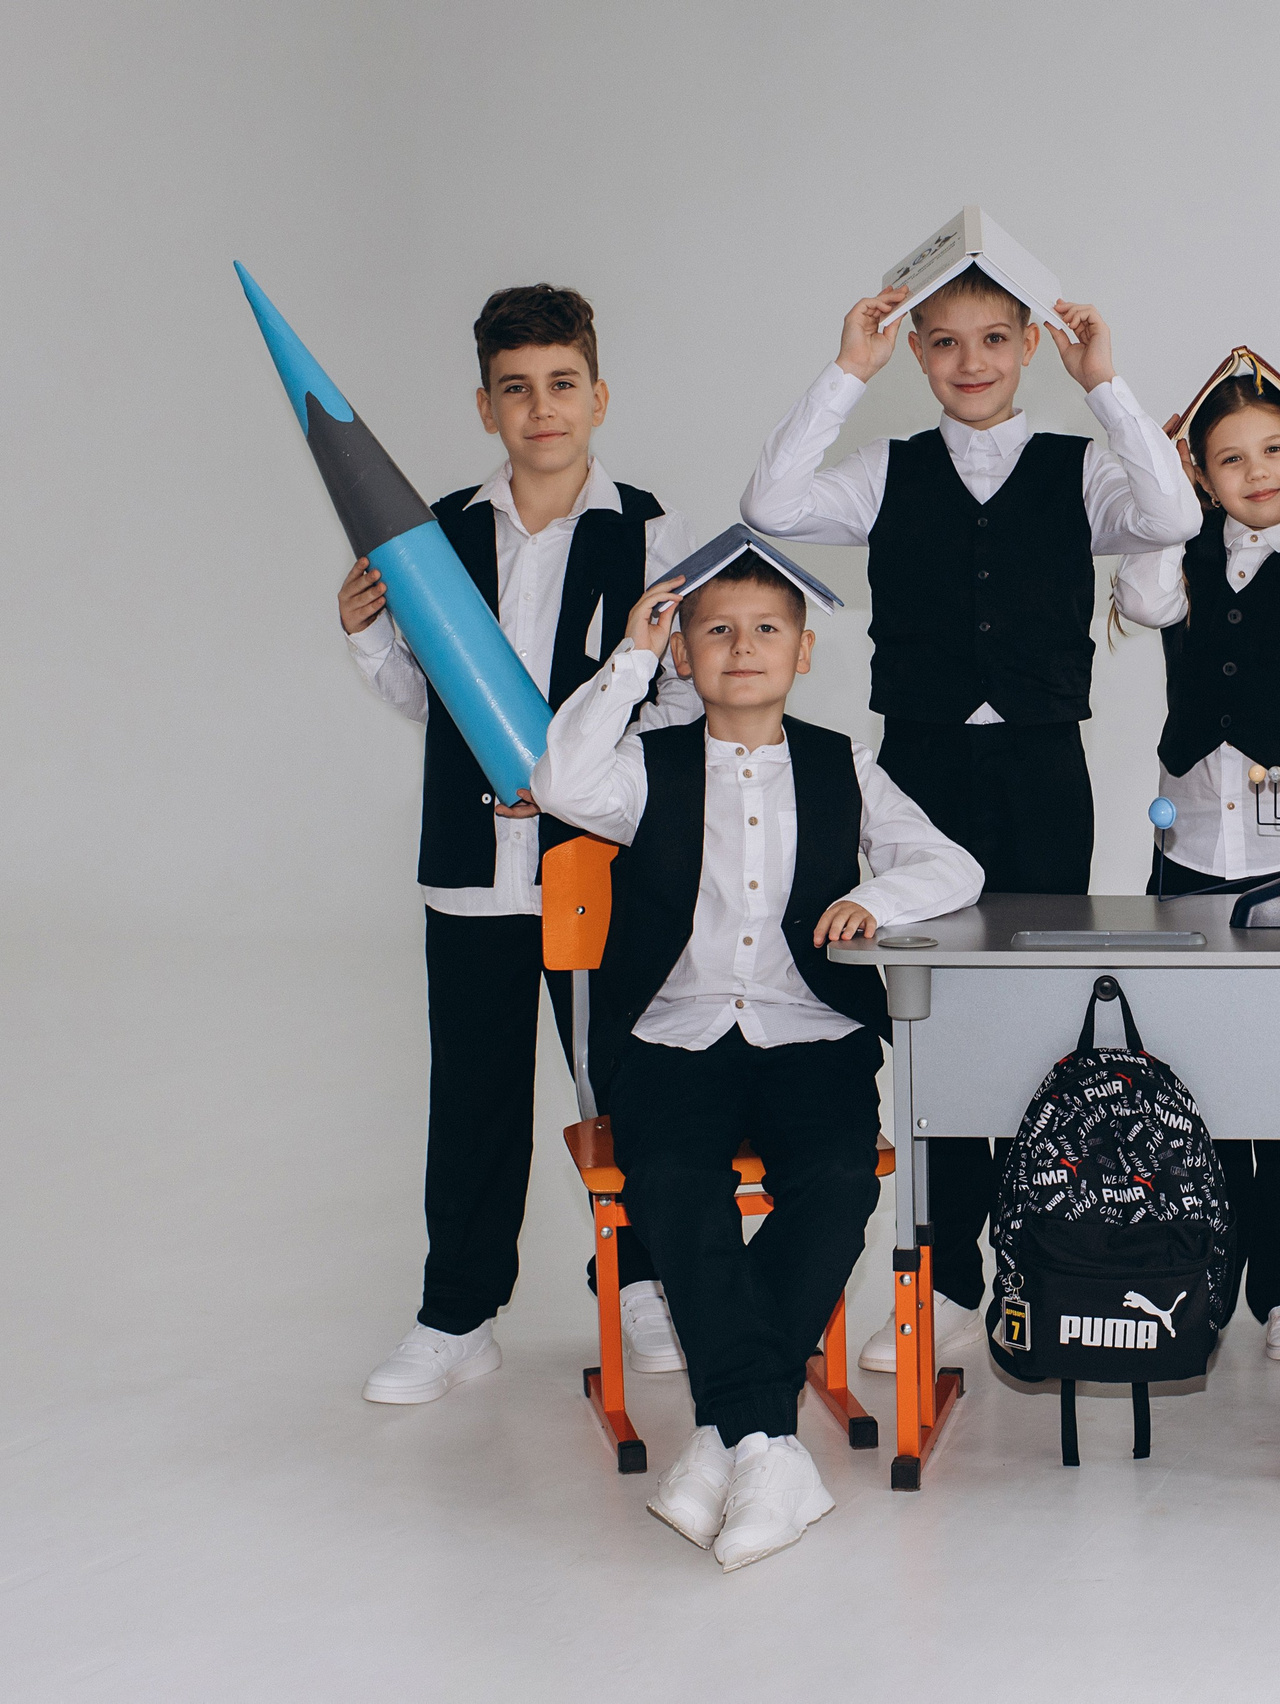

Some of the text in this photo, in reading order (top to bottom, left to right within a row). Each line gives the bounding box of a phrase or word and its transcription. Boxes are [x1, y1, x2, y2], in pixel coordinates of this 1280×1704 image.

[1099, 1054, 1148, 1066] PUMA
[1156, 1090, 1170, 1104] WE
[1154, 1102, 1192, 1134] PUMA
[1032, 1170, 1068, 1186] UMA
[1102, 1174, 1117, 1184] WE
[1102, 1186, 1145, 1203] PUMA
[1180, 1182, 1194, 1194] WE
[1100, 1206, 1122, 1218] COOL
[1012, 1321, 1020, 1340] 7
[1060, 1315, 1158, 1349] PUMA
